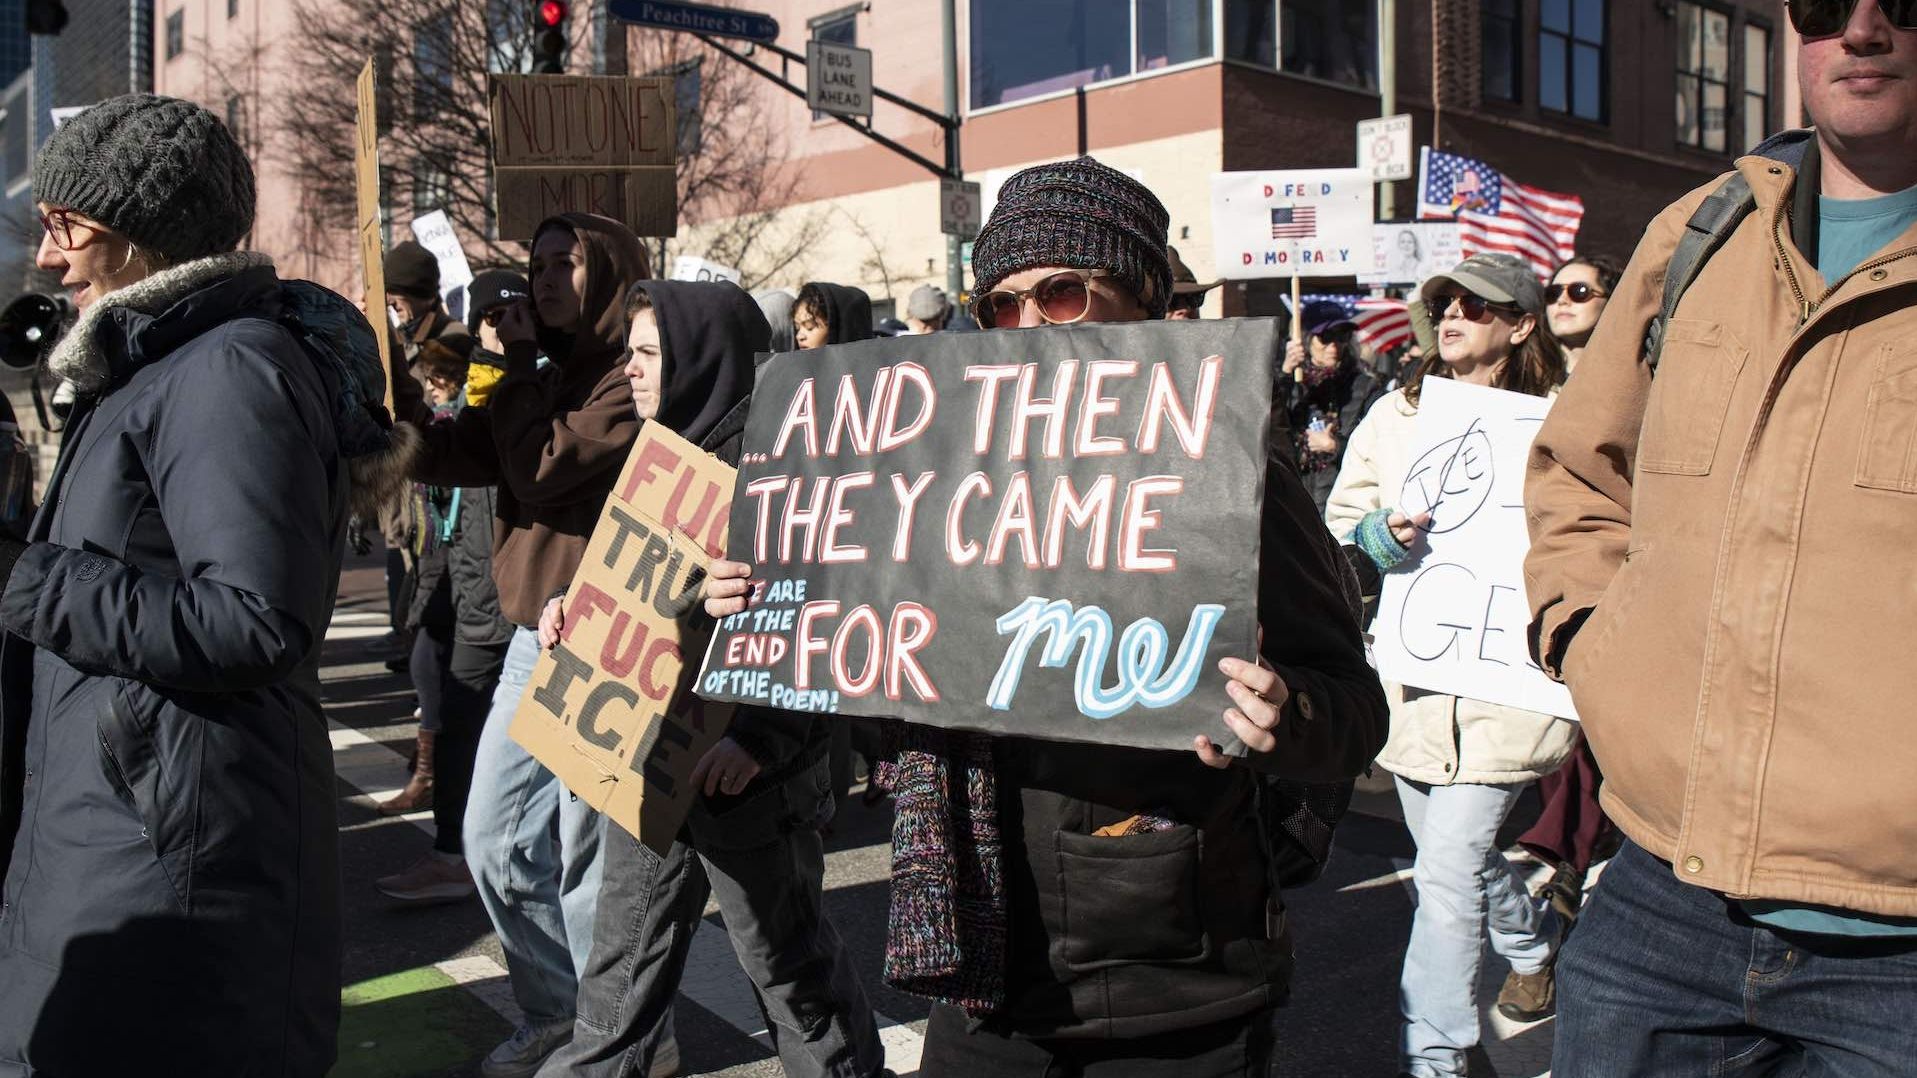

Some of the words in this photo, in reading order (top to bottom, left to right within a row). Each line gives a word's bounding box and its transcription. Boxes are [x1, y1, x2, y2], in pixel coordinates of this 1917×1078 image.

[641, 3, 726, 30] Peachtree
[730, 16, 748, 34] St
[827, 52, 853, 67] BUS
[822, 71, 856, 88] LANE
[820, 89, 862, 107] AHEAD
[501, 83, 577, 156] NOT
[584, 83, 660, 154] ONE
[963, 354, 1225, 462] THEN
[1408, 446, 1485, 513] ICE
[622, 437, 731, 560] FUC
[745, 470, 937, 566] THEY
[945, 470, 1186, 573] CAME
[603, 505, 708, 633] TRU
[765, 578, 808, 603] ARE
[723, 609, 750, 632] AT
[753, 608, 796, 633] THE
[1400, 563, 1552, 672] GE
[724, 633, 789, 669] END
[794, 600, 940, 701] FOR
[704, 669, 730, 694] OF
[730, 670, 771, 699] THE
[770, 683, 840, 713] POEM!
